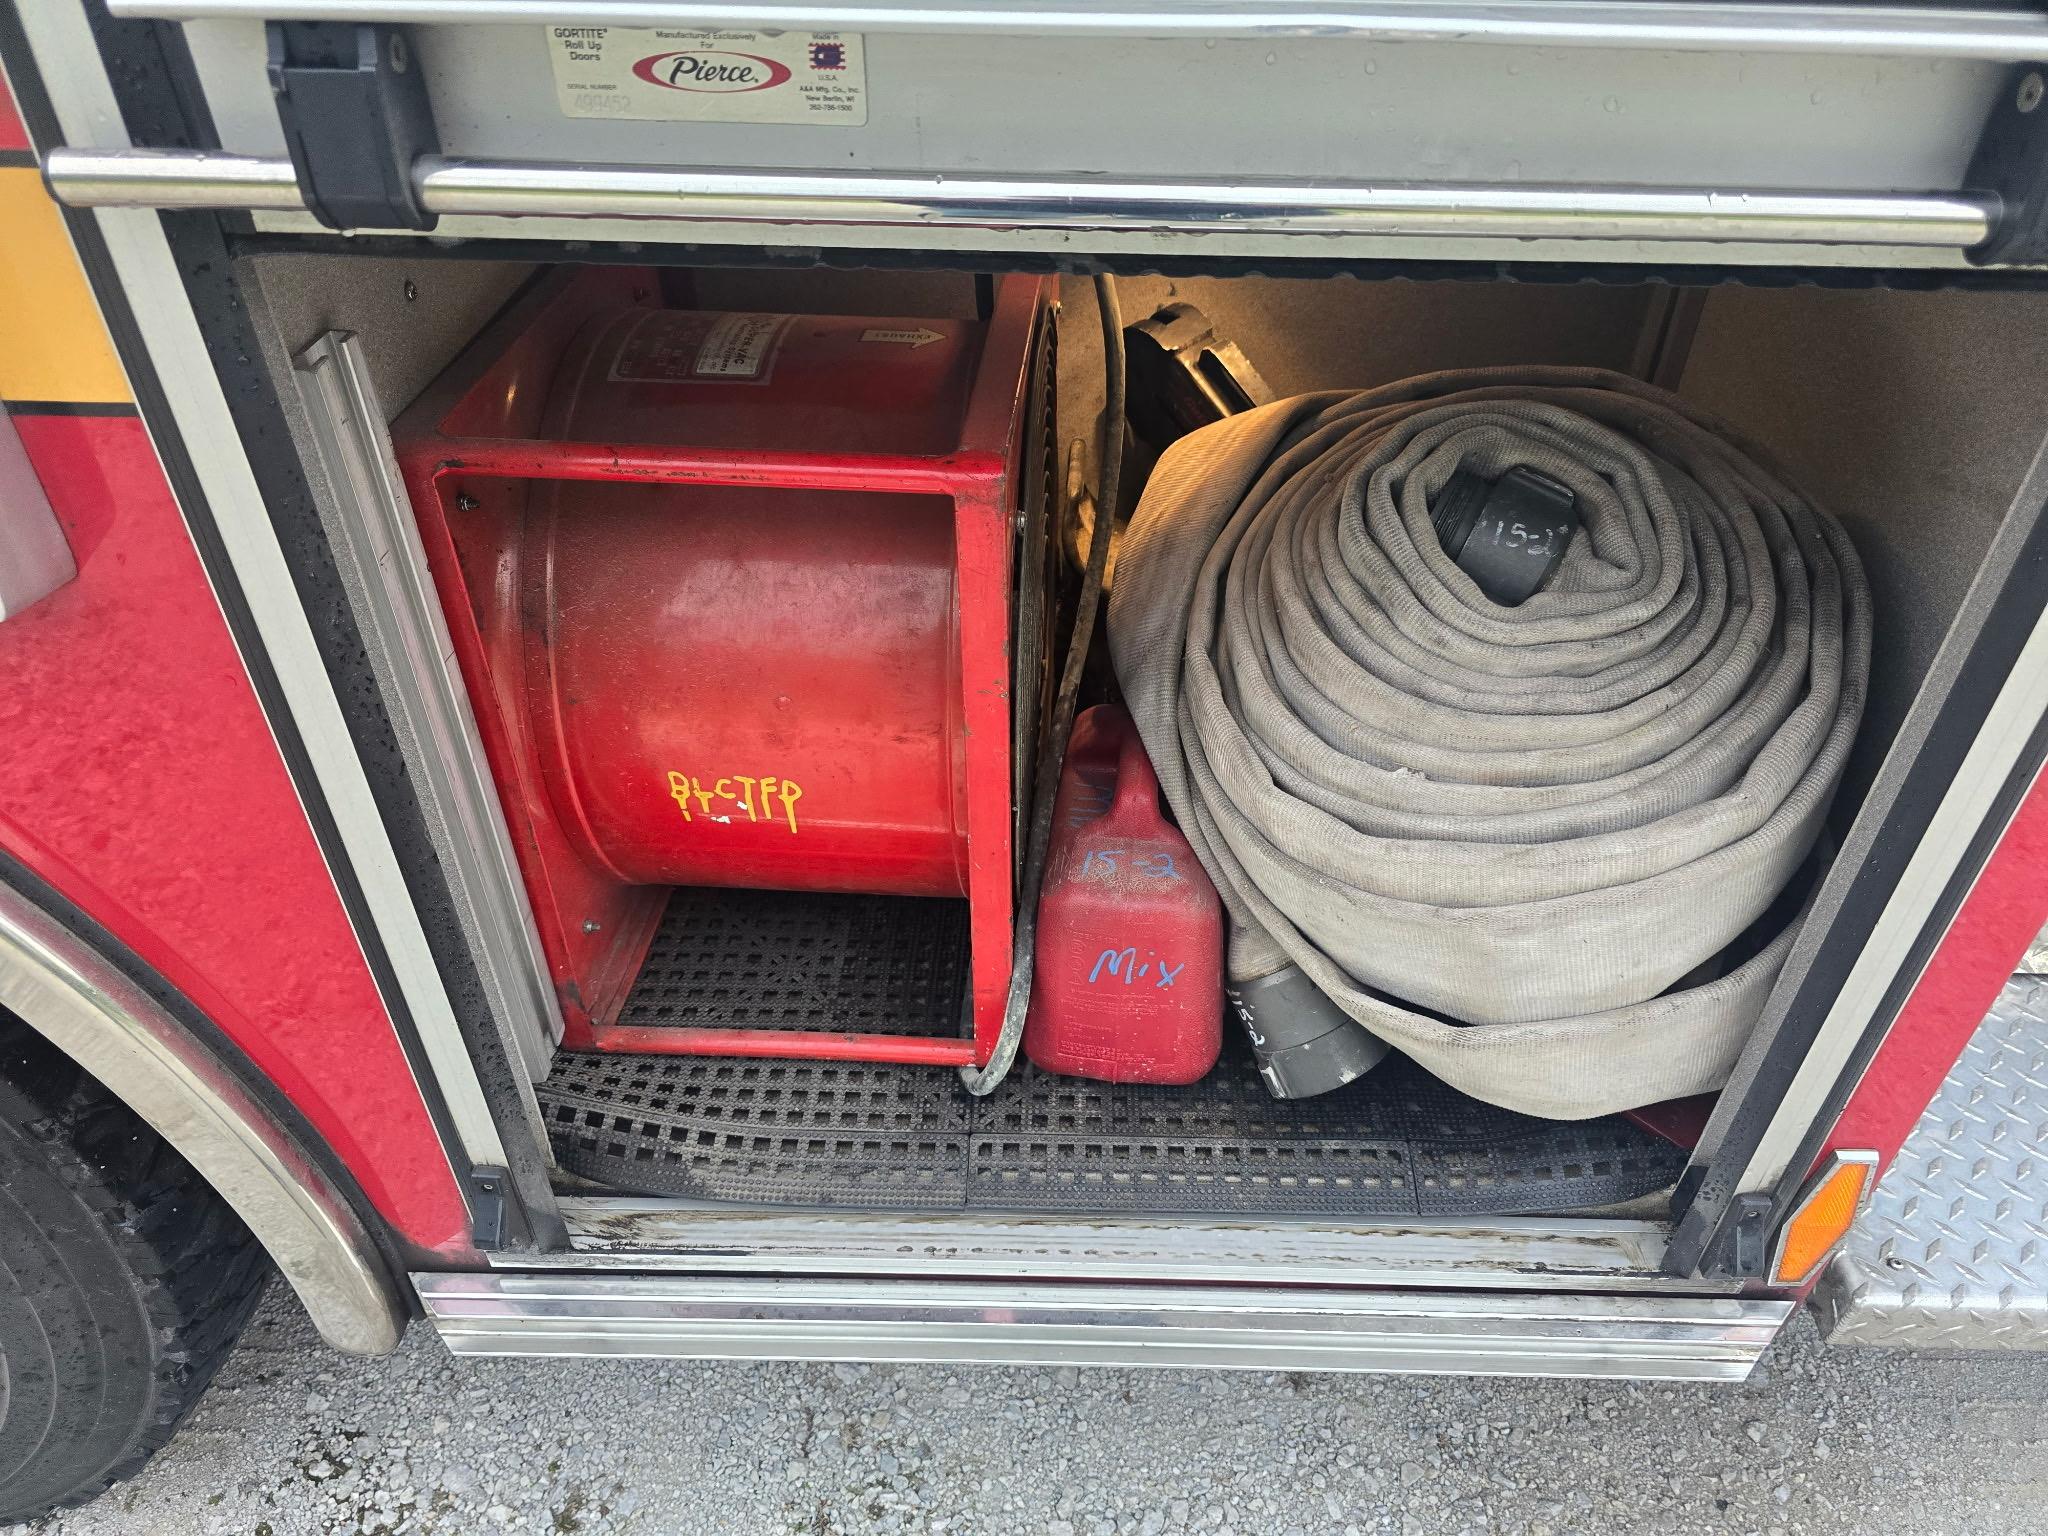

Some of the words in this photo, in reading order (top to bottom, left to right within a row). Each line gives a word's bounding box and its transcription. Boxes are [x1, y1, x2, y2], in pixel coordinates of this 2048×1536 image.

[655, 30, 710, 40] Manufactured
[712, 32, 756, 43] Exclusively
[564, 39, 584, 50] Roll
[587, 40, 602, 53] Up
[699, 41, 714, 49] For
[569, 51, 601, 62] Doors
[668, 55, 755, 86] Pierce
[566, 82, 588, 91] SERIAL
[589, 83, 617, 92] NUMBER
[1088, 945, 1185, 988] Mix
